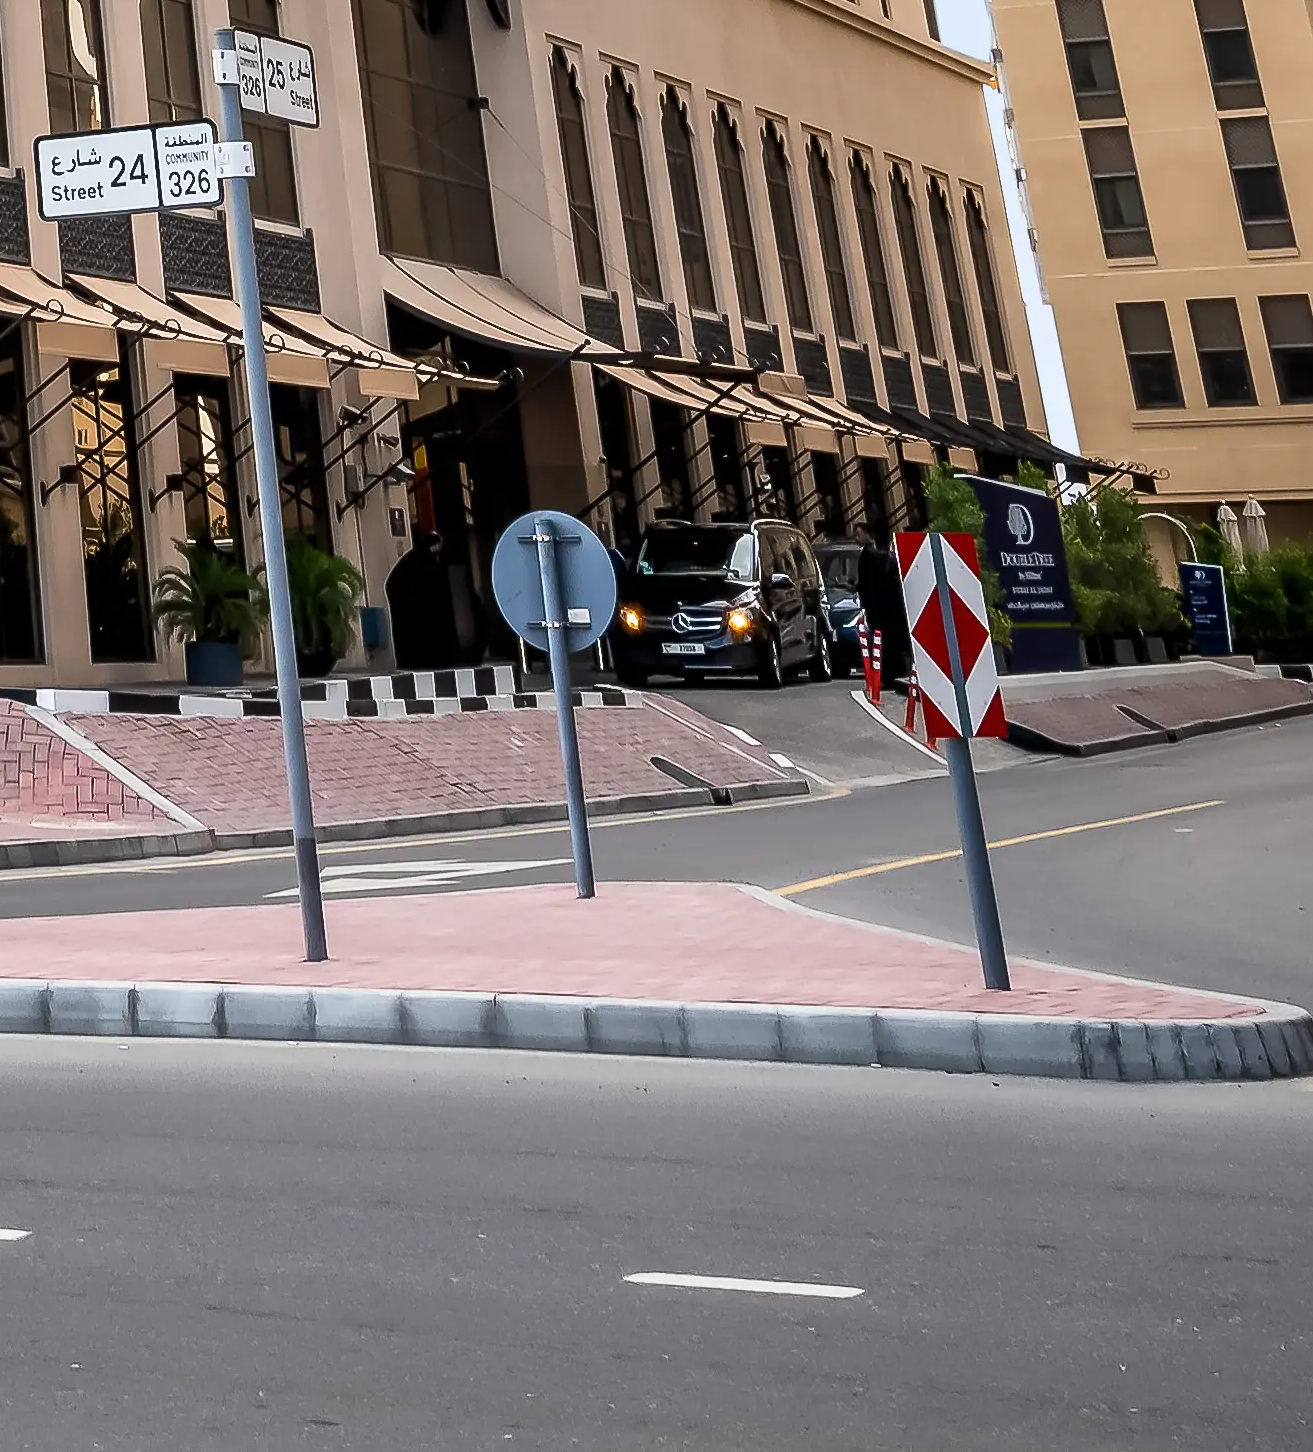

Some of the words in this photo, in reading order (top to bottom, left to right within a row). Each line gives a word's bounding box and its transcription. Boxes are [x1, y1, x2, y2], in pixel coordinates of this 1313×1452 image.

[241, 73, 262, 98] 326
[266, 58, 286, 90] 25
[289, 89, 314, 111] Street
[51, 147, 102, 176] شارع
[108, 153, 149, 188] 24
[165, 150, 209, 166] COMMUNITY
[51, 181, 105, 202] Street
[168, 168, 211, 198] 326
